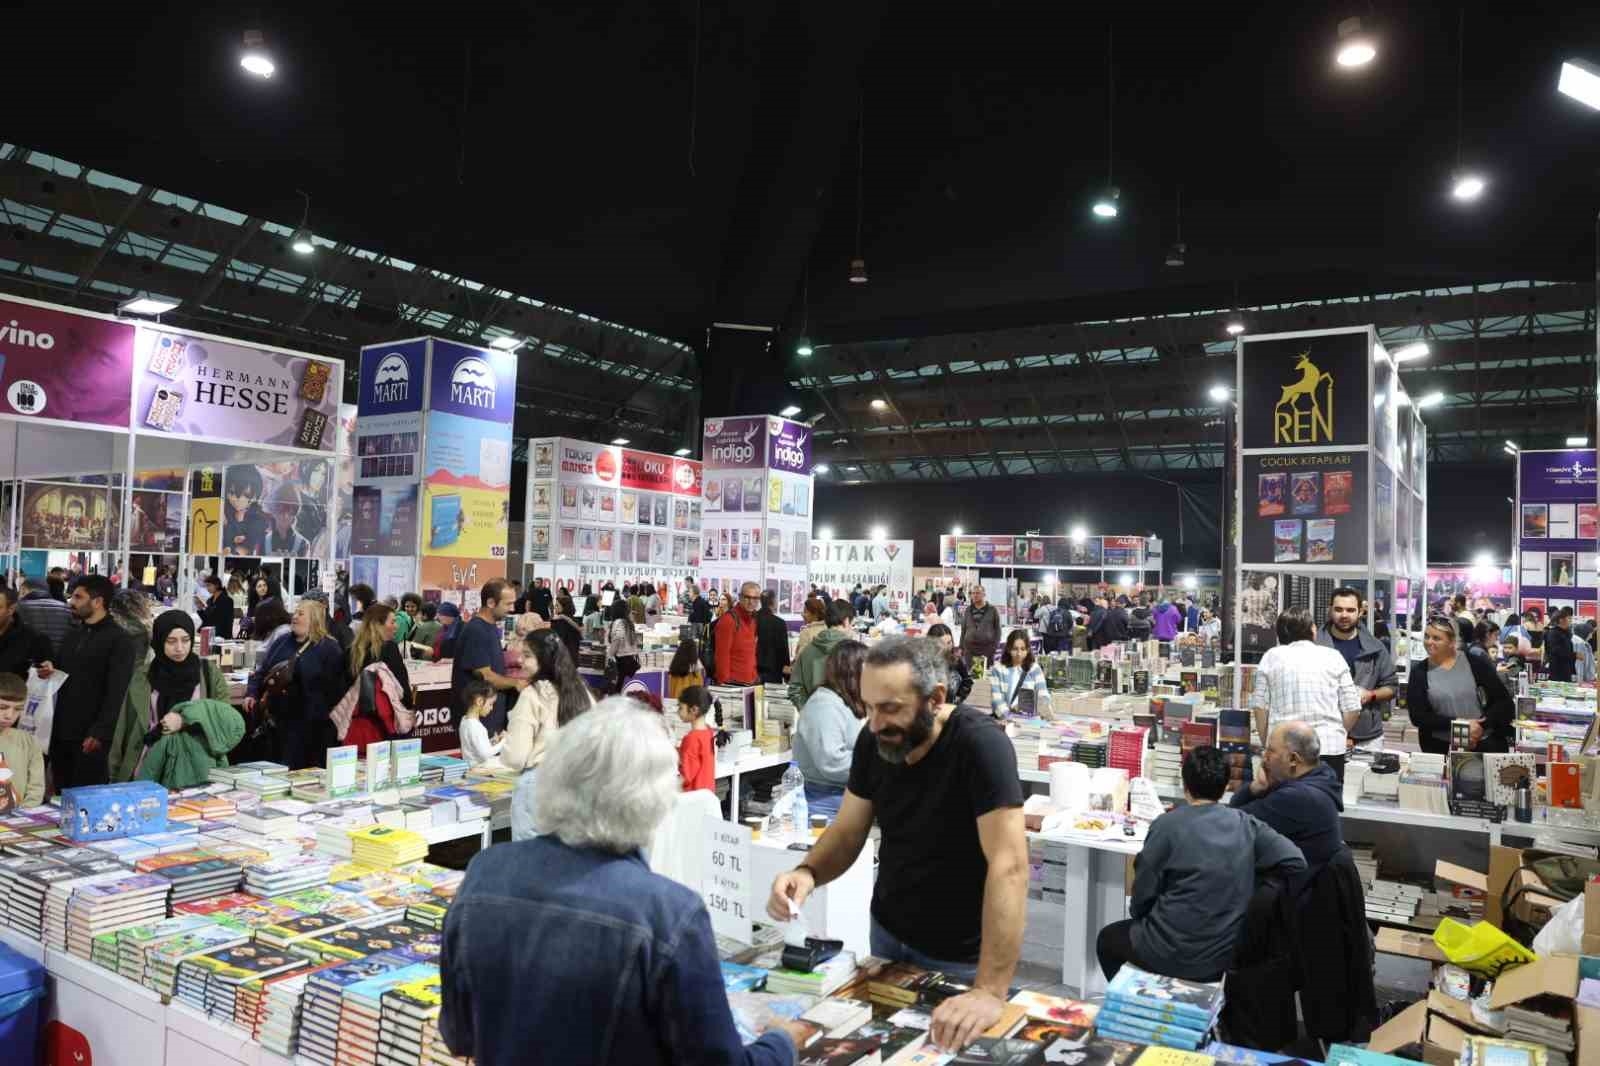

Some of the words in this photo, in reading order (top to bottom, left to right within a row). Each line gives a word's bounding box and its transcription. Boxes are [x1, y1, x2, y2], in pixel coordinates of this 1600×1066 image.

[197, 366, 291, 389] HERMANN
[195, 380, 289, 415] HESSE
[1275, 396, 1333, 443] REN
[712, 444, 754, 463] indigo
[775, 443, 805, 468] indigo
[644, 462, 664, 474] OKU
[712, 851, 725, 866] 60
[729, 856, 742, 872] TL
[709, 894, 728, 912] 150
[732, 902, 745, 918] TL
